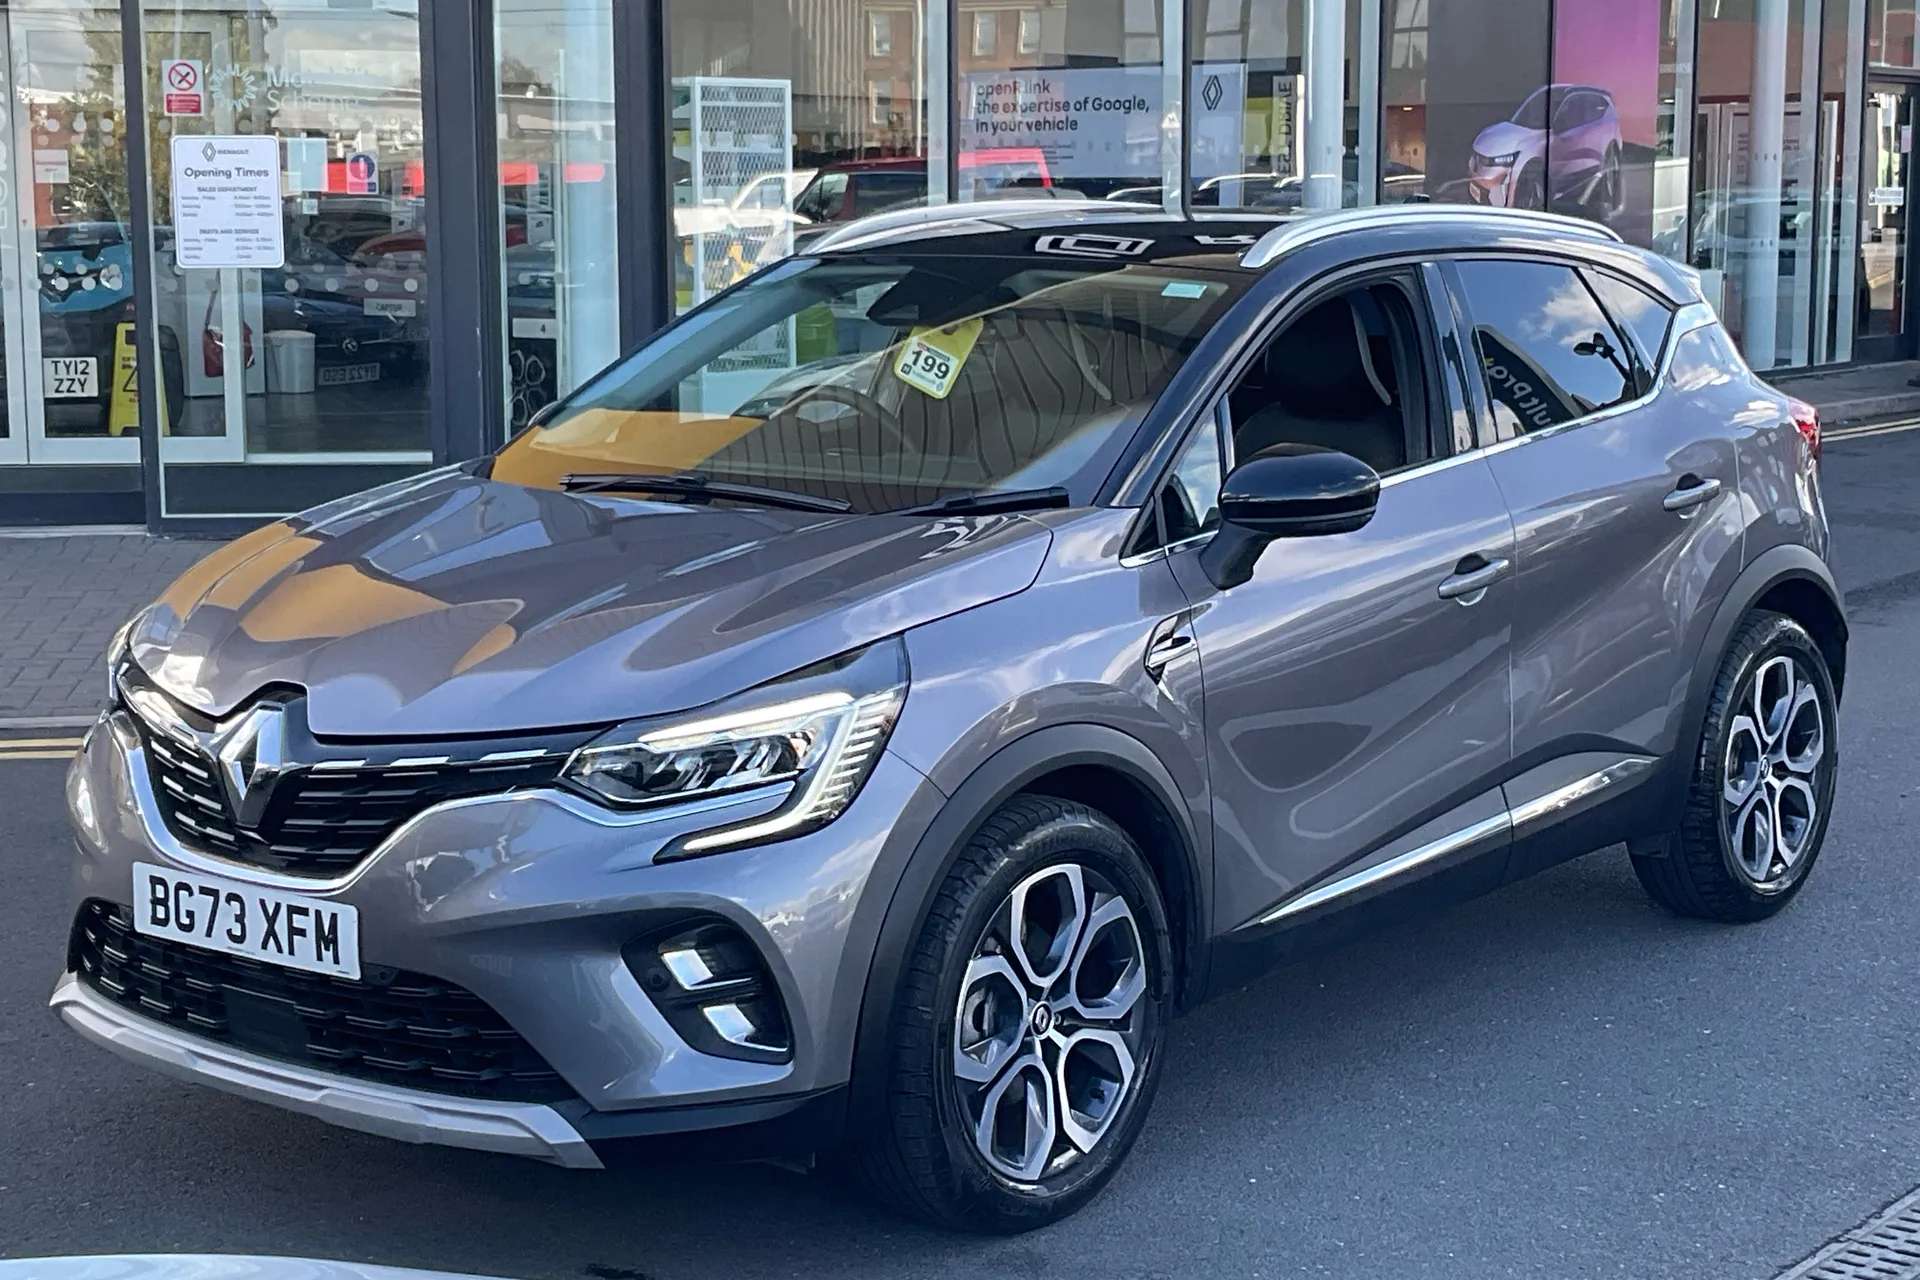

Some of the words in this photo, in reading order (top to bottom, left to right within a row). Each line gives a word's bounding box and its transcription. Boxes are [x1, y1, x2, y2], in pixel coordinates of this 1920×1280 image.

[976, 99, 999, 114] the
[1002, 97, 1070, 117] expertise
[1073, 96, 1090, 112] of
[1092, 95, 1150, 114] Google,
[976, 118, 988, 133] in
[991, 120, 1024, 136] your
[1026, 116, 1078, 132] vehicle
[183, 166, 232, 180] Opening
[234, 166, 270, 178] Times
[51, 360, 90, 376] TY12
[911, 349, 950, 380] 199
[54, 377, 88, 394] ZZY
[149, 874, 247, 945] BG73
[258, 897, 340, 966] XFM
